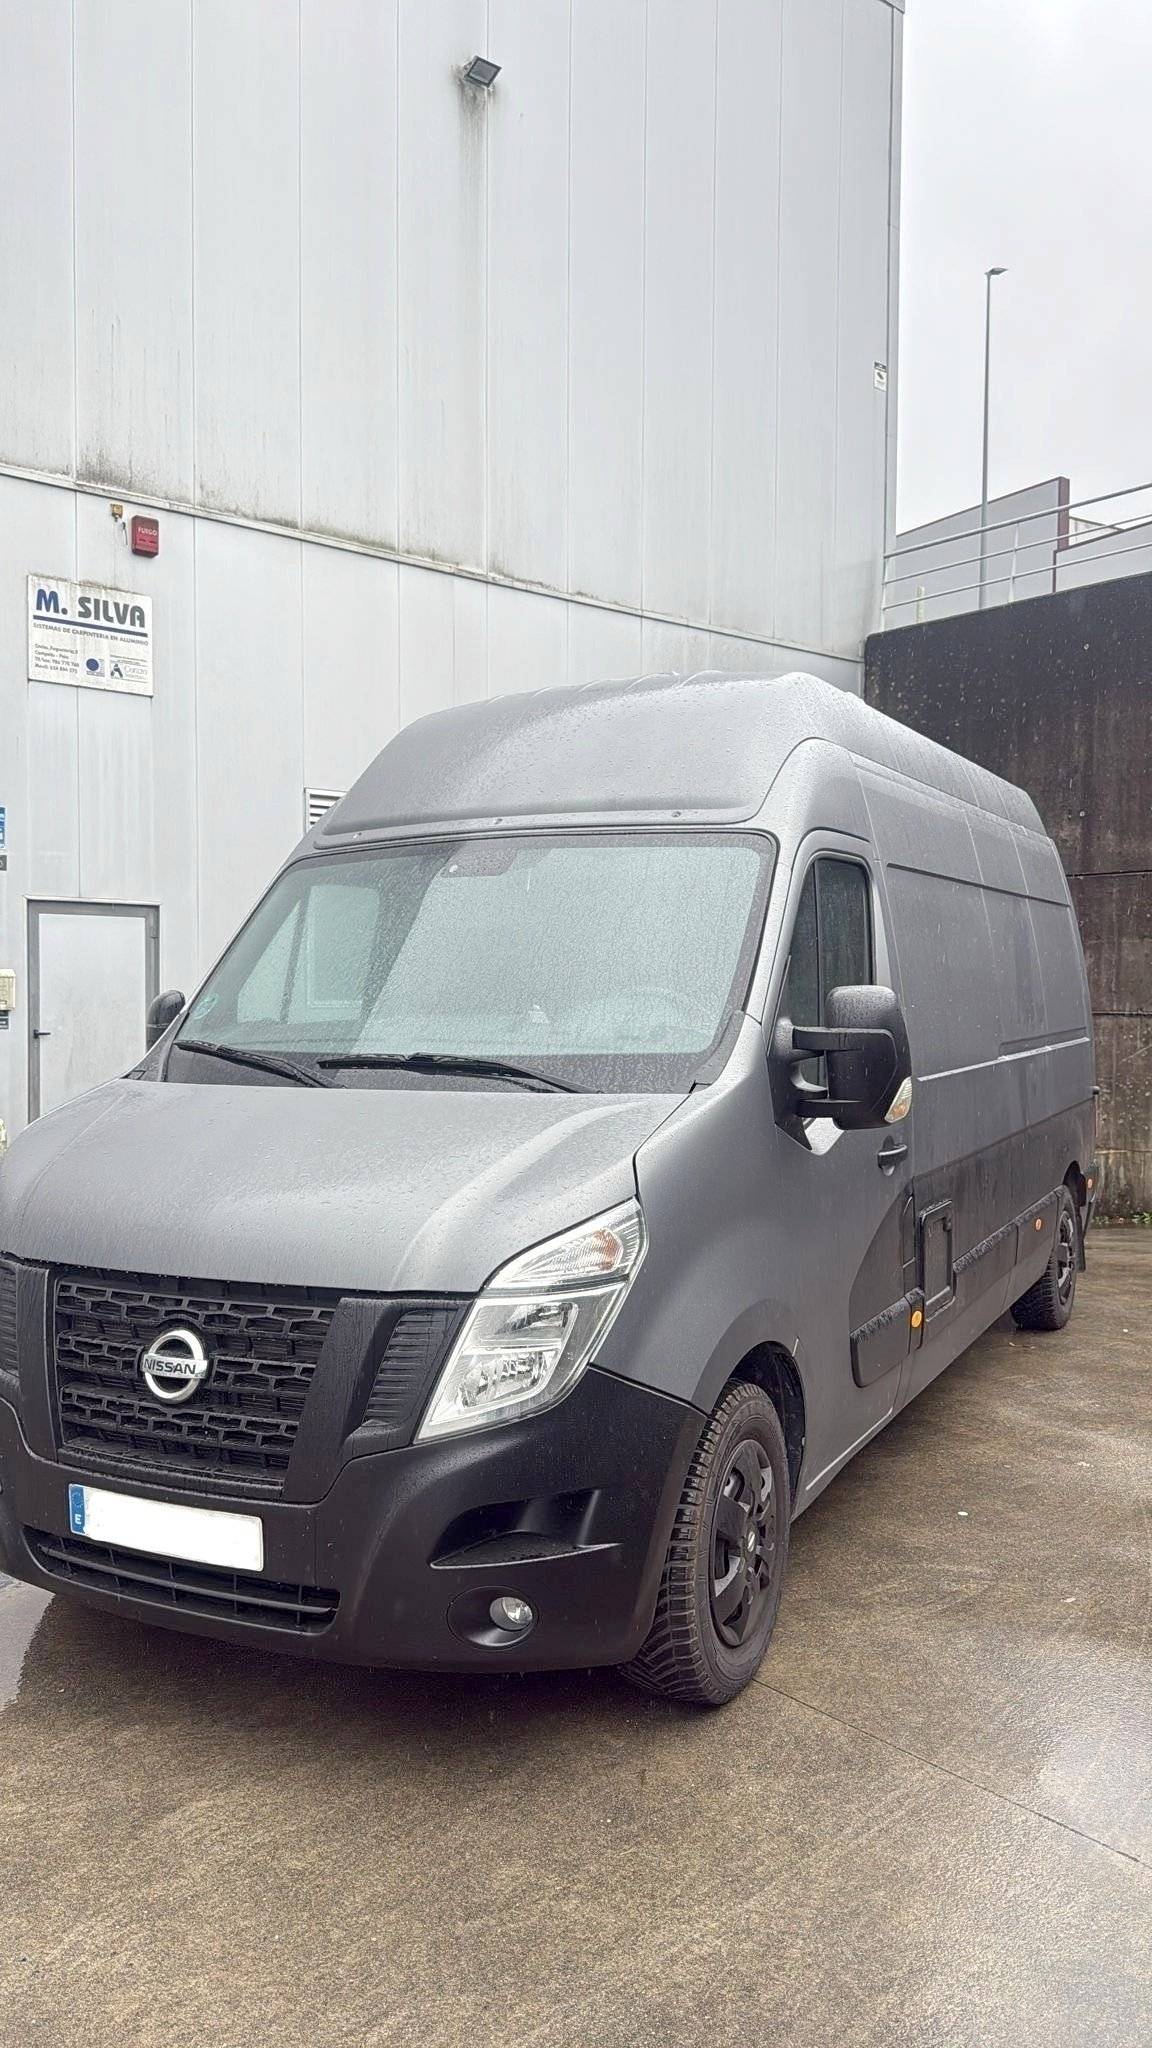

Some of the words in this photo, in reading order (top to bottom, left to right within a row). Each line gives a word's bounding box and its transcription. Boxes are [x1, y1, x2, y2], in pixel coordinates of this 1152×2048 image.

[137, 527, 158, 536] FUEGO
[36, 588, 68, 615] M.
[78, 596, 145, 628] SILVA
[33, 622, 61, 632] SISTEMAS
[120, 637, 149, 646] ALUMINIO
[144, 1358, 196, 1375] NISSAN
[75, 1513, 82, 1525] E
